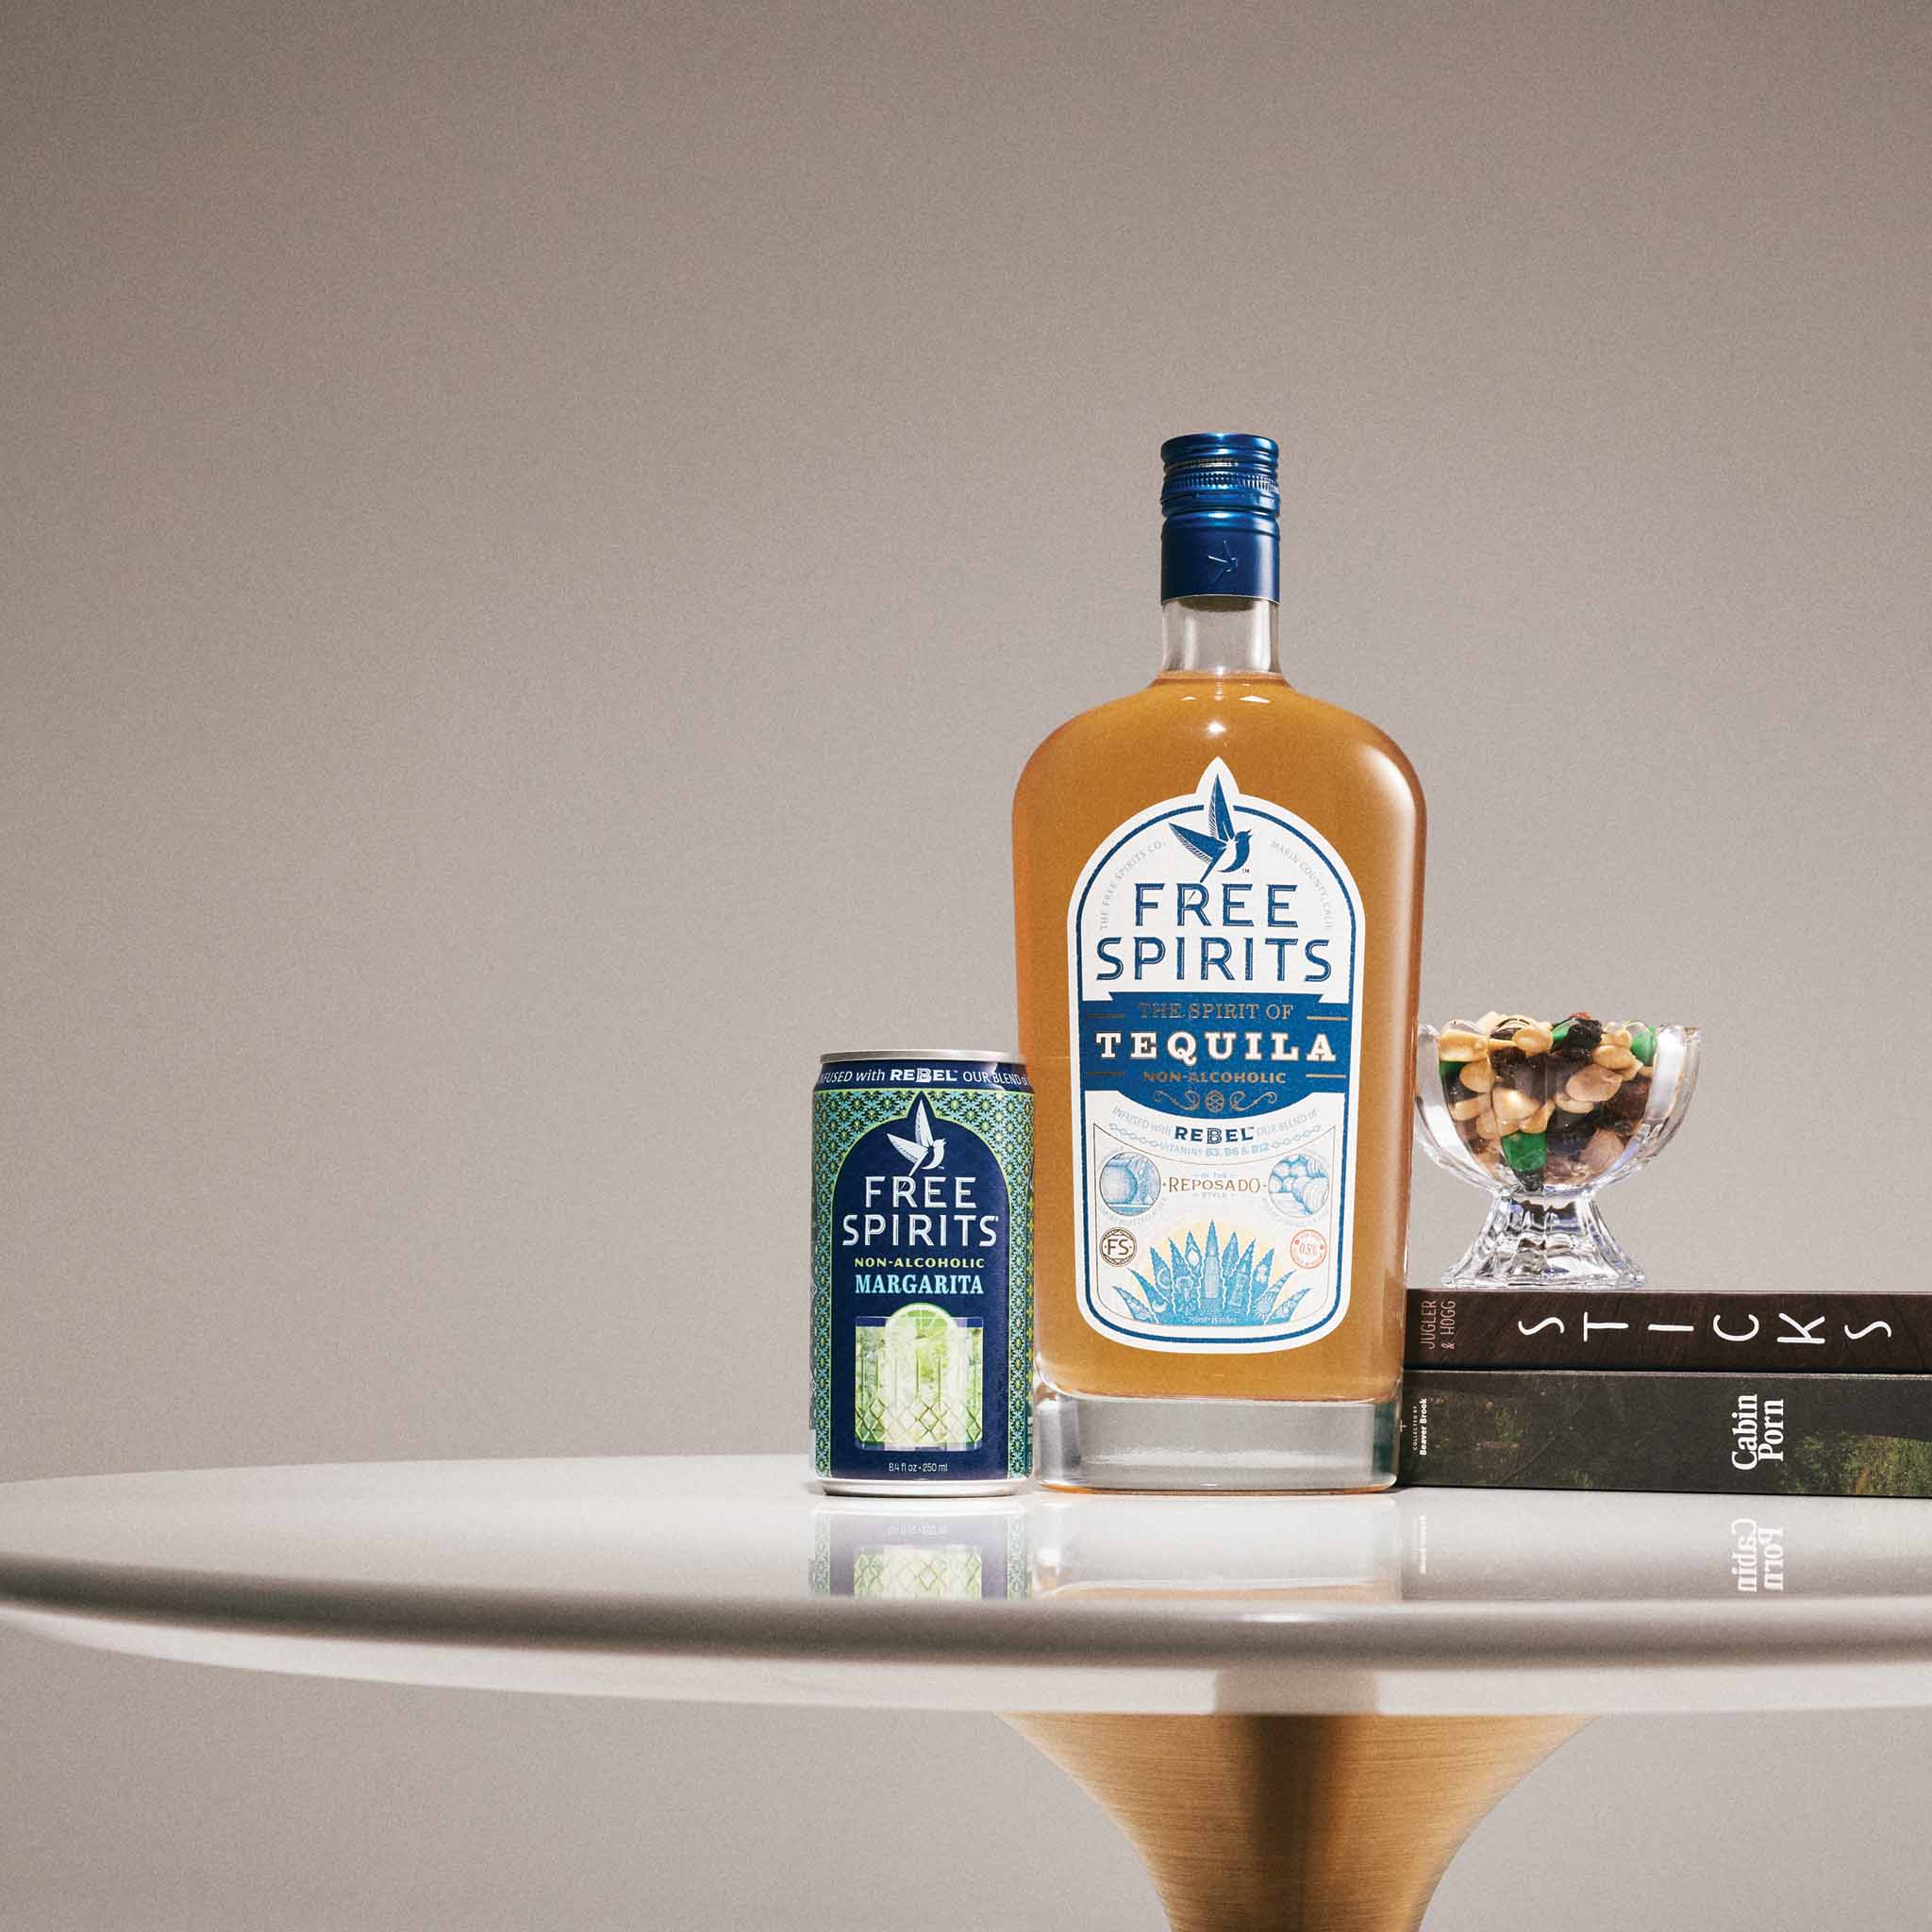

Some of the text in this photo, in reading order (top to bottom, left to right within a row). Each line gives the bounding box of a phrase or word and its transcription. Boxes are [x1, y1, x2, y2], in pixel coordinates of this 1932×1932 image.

[1134, 882, 1299, 928] FREE
[1095, 936, 1333, 983] SPIRITS
[1139, 1003, 1294, 1020] THE SPIRIT OF
[1095, 1031, 1337, 1067] TEQUILA
[856, 1068, 886, 1081] with
[889, 1068, 958, 1084] REBEL
[962, 1071, 991, 1083] OUR
[991, 1073, 1023, 1085] BLEND
[1142, 1071, 1287, 1084] NON-ALCOHOLIC
[1174, 1125, 1254, 1145] REBEL
[864, 1175, 977, 1208] FREE
[1169, 1176, 1261, 1193] REPOSADO
[841, 1214, 1000, 1247] SPIRITS
[854, 1257, 986, 1269] NON-ALCOHOLIC
[1107, 1239, 1130, 1256] FS
[855, 1274, 985, 1295] MARGARITA
[1420, 1300, 1437, 1350] JUGLER
[1440, 1300, 1457, 1350] & HOGG
[1517, 1311, 1892, 1345] STICKS
[1419, 1398, 1427, 1456] Beaver Brook
[1731, 1393, 1758, 1471] Cabin
[1757, 1398, 1785, 1462] Porn
[908, 1464, 918, 1473] oz
[923, 1462, 938, 1473] 250
[939, 1463, 948, 1473] ml
